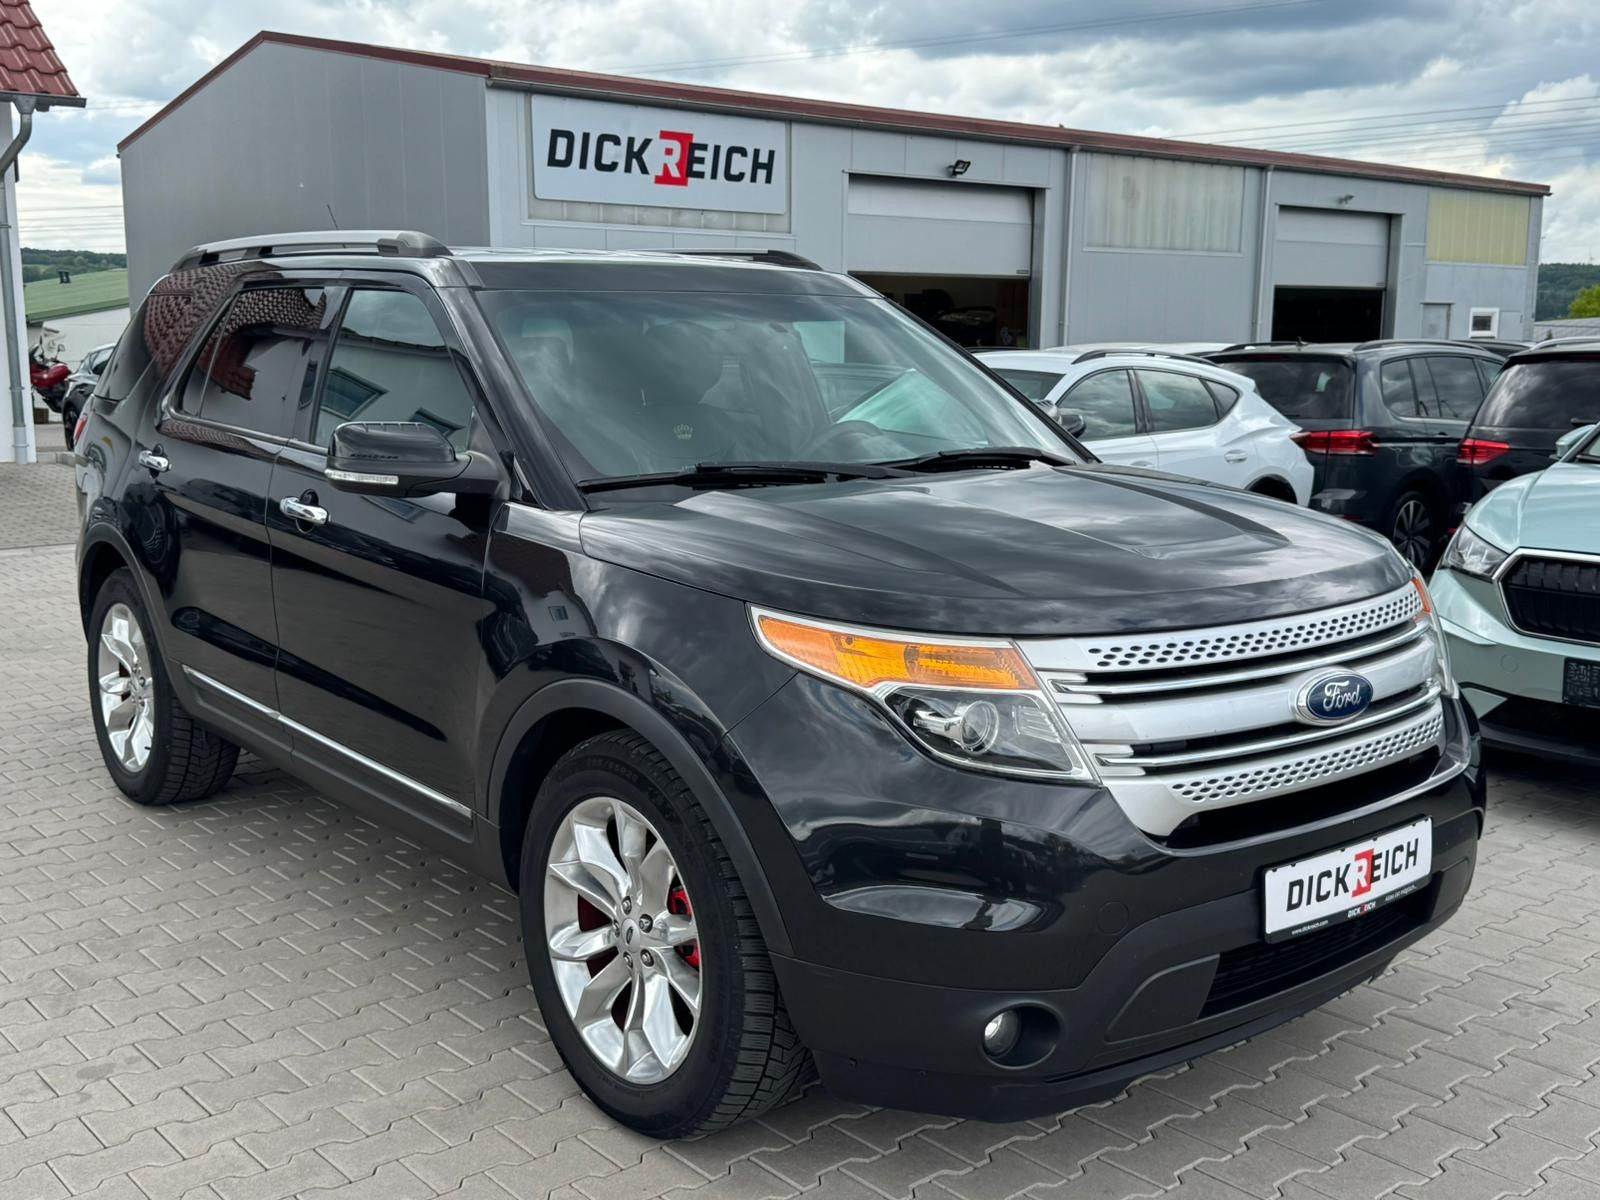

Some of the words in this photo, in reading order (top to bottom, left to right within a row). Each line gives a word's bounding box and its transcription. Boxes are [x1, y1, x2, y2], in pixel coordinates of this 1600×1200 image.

[547, 129, 775, 187] DICKREICH
[1323, 680, 1361, 712] Ford
[1286, 838, 1419, 912] DICKREICH
